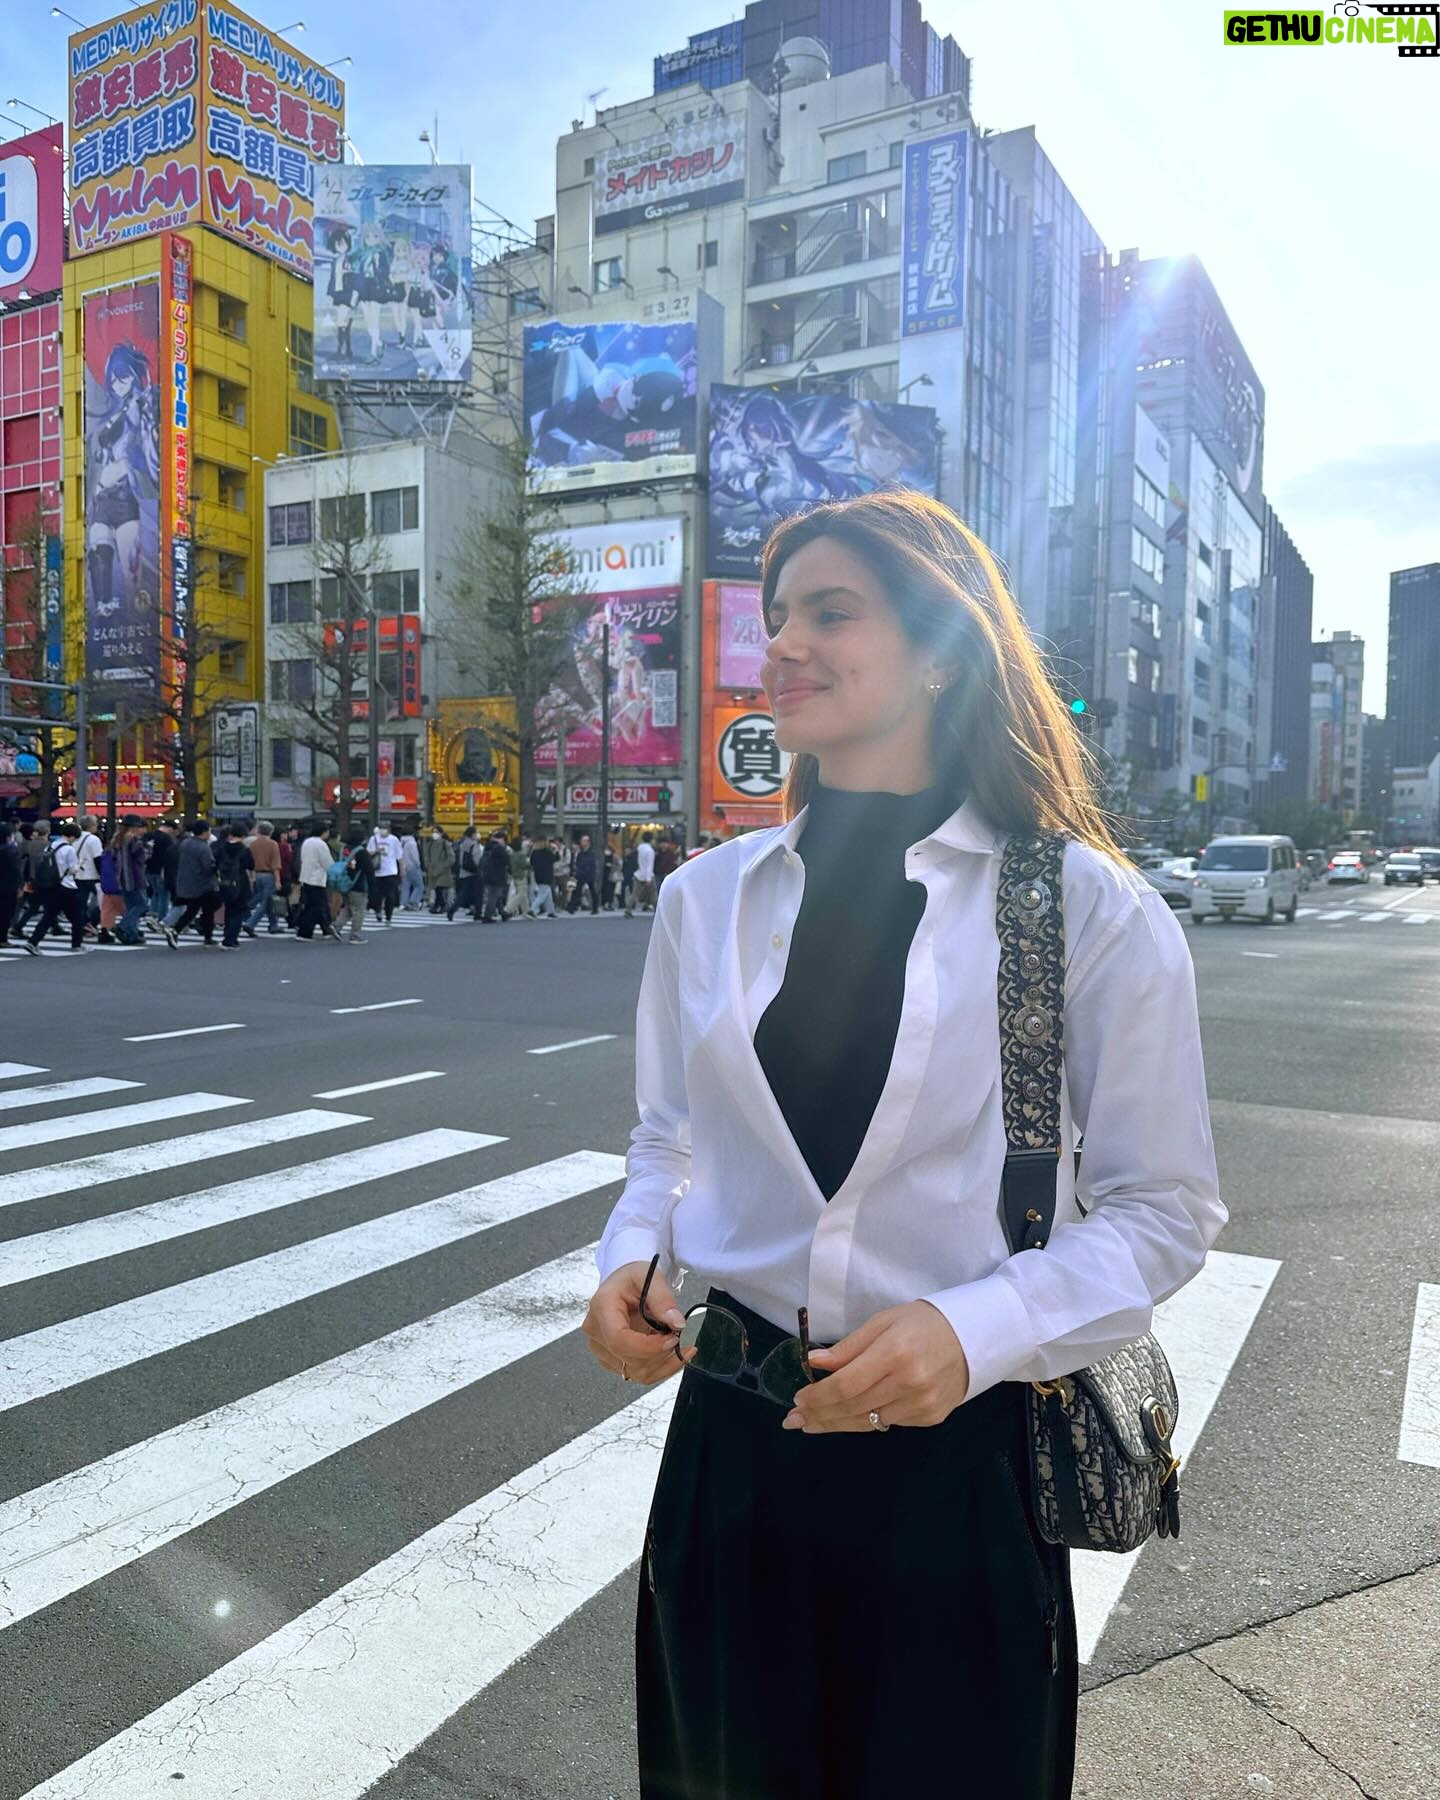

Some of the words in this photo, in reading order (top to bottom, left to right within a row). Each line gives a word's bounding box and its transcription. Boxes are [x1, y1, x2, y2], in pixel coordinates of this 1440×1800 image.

[74, 38, 195, 127] 激安販売
[209, 47, 340, 160] 激安販売
[73, 95, 194, 187] 高額買取
[208, 106, 313, 200] 高額買
[606, 142, 734, 201] メイドカジノ
[73, 162, 199, 249] Mulan
[545, 540, 665, 576] amiami
[729, 726, 783, 786] 質
[439, 791, 504, 806] ゴーゴカレー
[572, 787, 623, 803] COIC
[626, 788, 648, 801] ZIN
